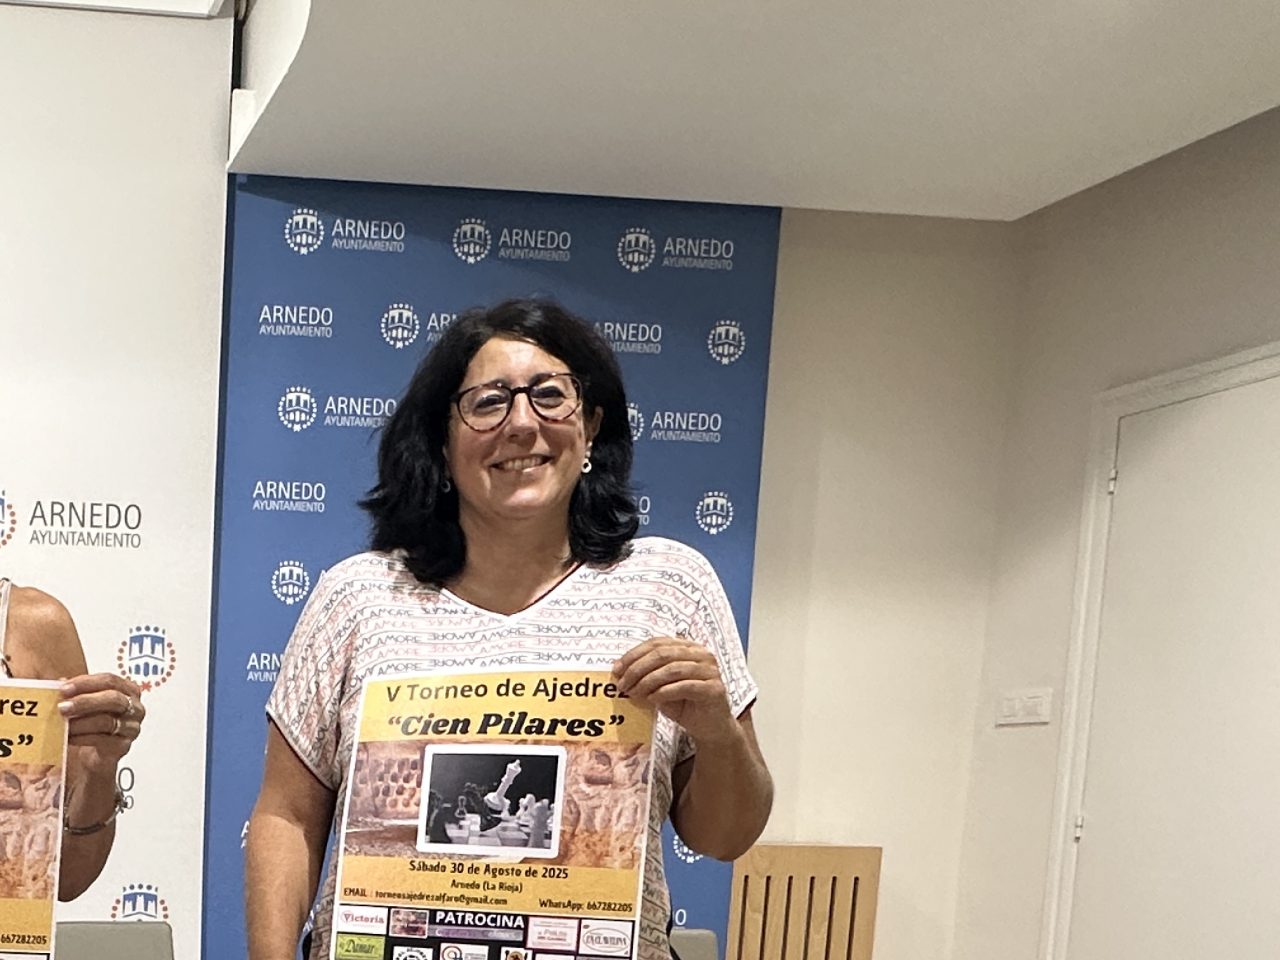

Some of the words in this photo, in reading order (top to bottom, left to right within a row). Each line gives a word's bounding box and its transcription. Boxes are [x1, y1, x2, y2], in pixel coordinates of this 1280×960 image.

[331, 218, 405, 241] ARNEDO
[498, 227, 571, 250] ARNEDO
[332, 238, 405, 253] AYUNTAMIENTO
[498, 248, 571, 262] AYUNTAMIENTO
[663, 237, 734, 259] ARNEDO
[662, 257, 733, 271] AYUNTAMIENTO
[259, 305, 333, 327] ARNEDO
[259, 324, 333, 338] AYUNTAMIENTO
[651, 411, 722, 432] ARNEDO
[651, 428, 721, 443] AYUNTAMIENTO
[253, 481, 326, 501] ARNEDO
[29, 500, 142, 530] ARNEDO
[253, 499, 325, 513] AYUNTAMIENTO
[30, 530, 141, 549] AYUNTAMIENTO
[386, 685, 400, 702] V
[407, 682, 488, 701] Torneo
[496, 679, 526, 698] de
[388, 713, 470, 736] “Cien
[476, 711, 625, 738] Pilares”
[409, 860, 447, 873] Sábado
[450, 862, 464, 874] 30
[467, 863, 480, 875] de
[483, 864, 521, 878] Agosto
[524, 867, 538, 878] de
[541, 867, 569, 879] 2025
[451, 879, 480, 891] Arnedo
[483, 880, 496, 891] (La
[498, 881, 523, 893] Rioja)
[436, 911, 525, 928] PATROCINA
